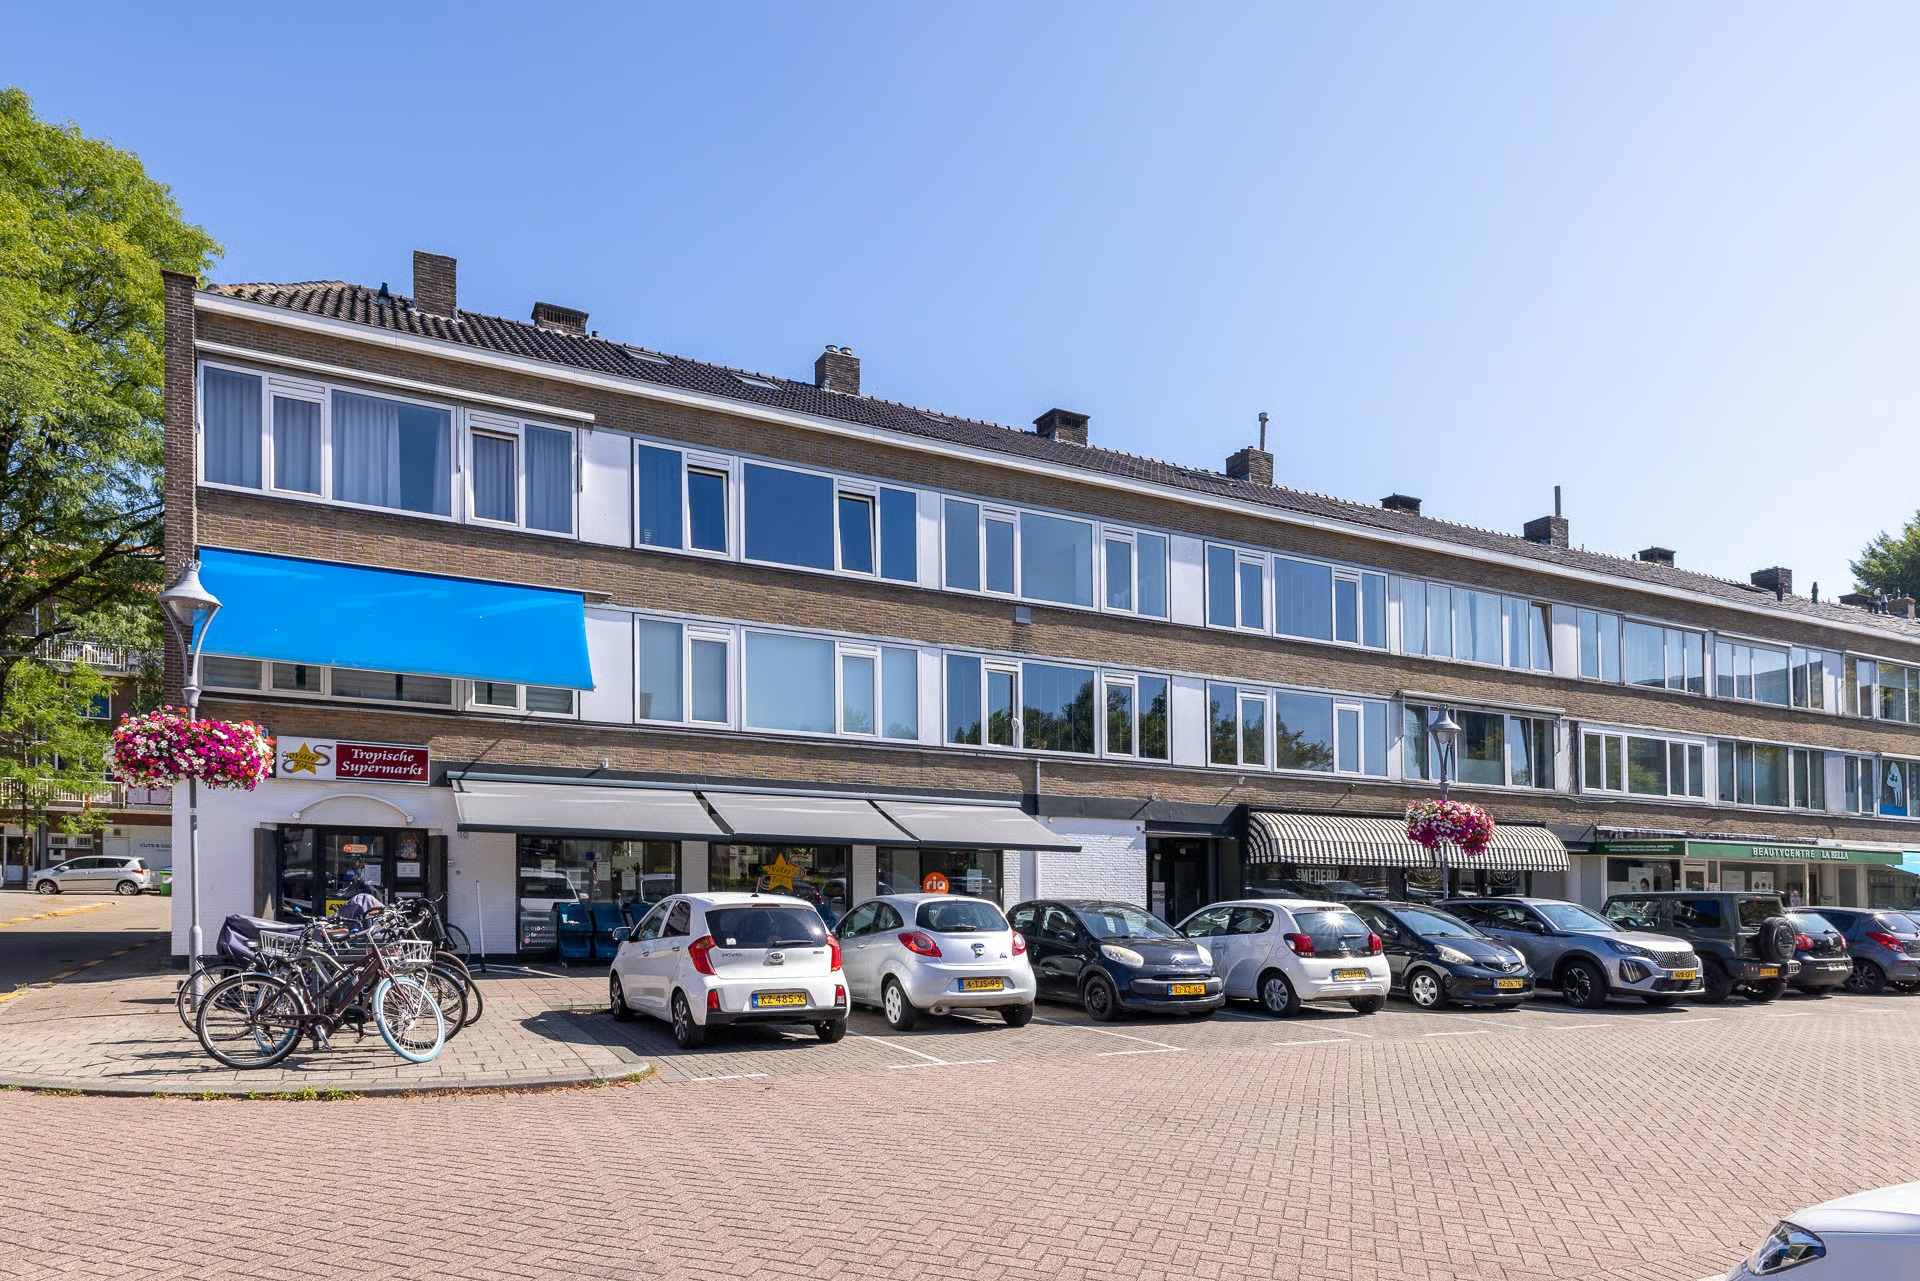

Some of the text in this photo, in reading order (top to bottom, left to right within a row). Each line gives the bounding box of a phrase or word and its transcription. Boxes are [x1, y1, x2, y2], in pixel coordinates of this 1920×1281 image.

[351, 748, 415, 764] Tropische
[294, 762, 313, 771] Toko
[341, 761, 424, 776] Supermarkt
[1753, 847, 1849, 860] BEAUTYCENTRE LA BELLA
[926, 875, 946, 890] ria
[966, 980, 1000, 989] 4-TJS-95
[761, 994, 803, 1005] KZ-485-X
